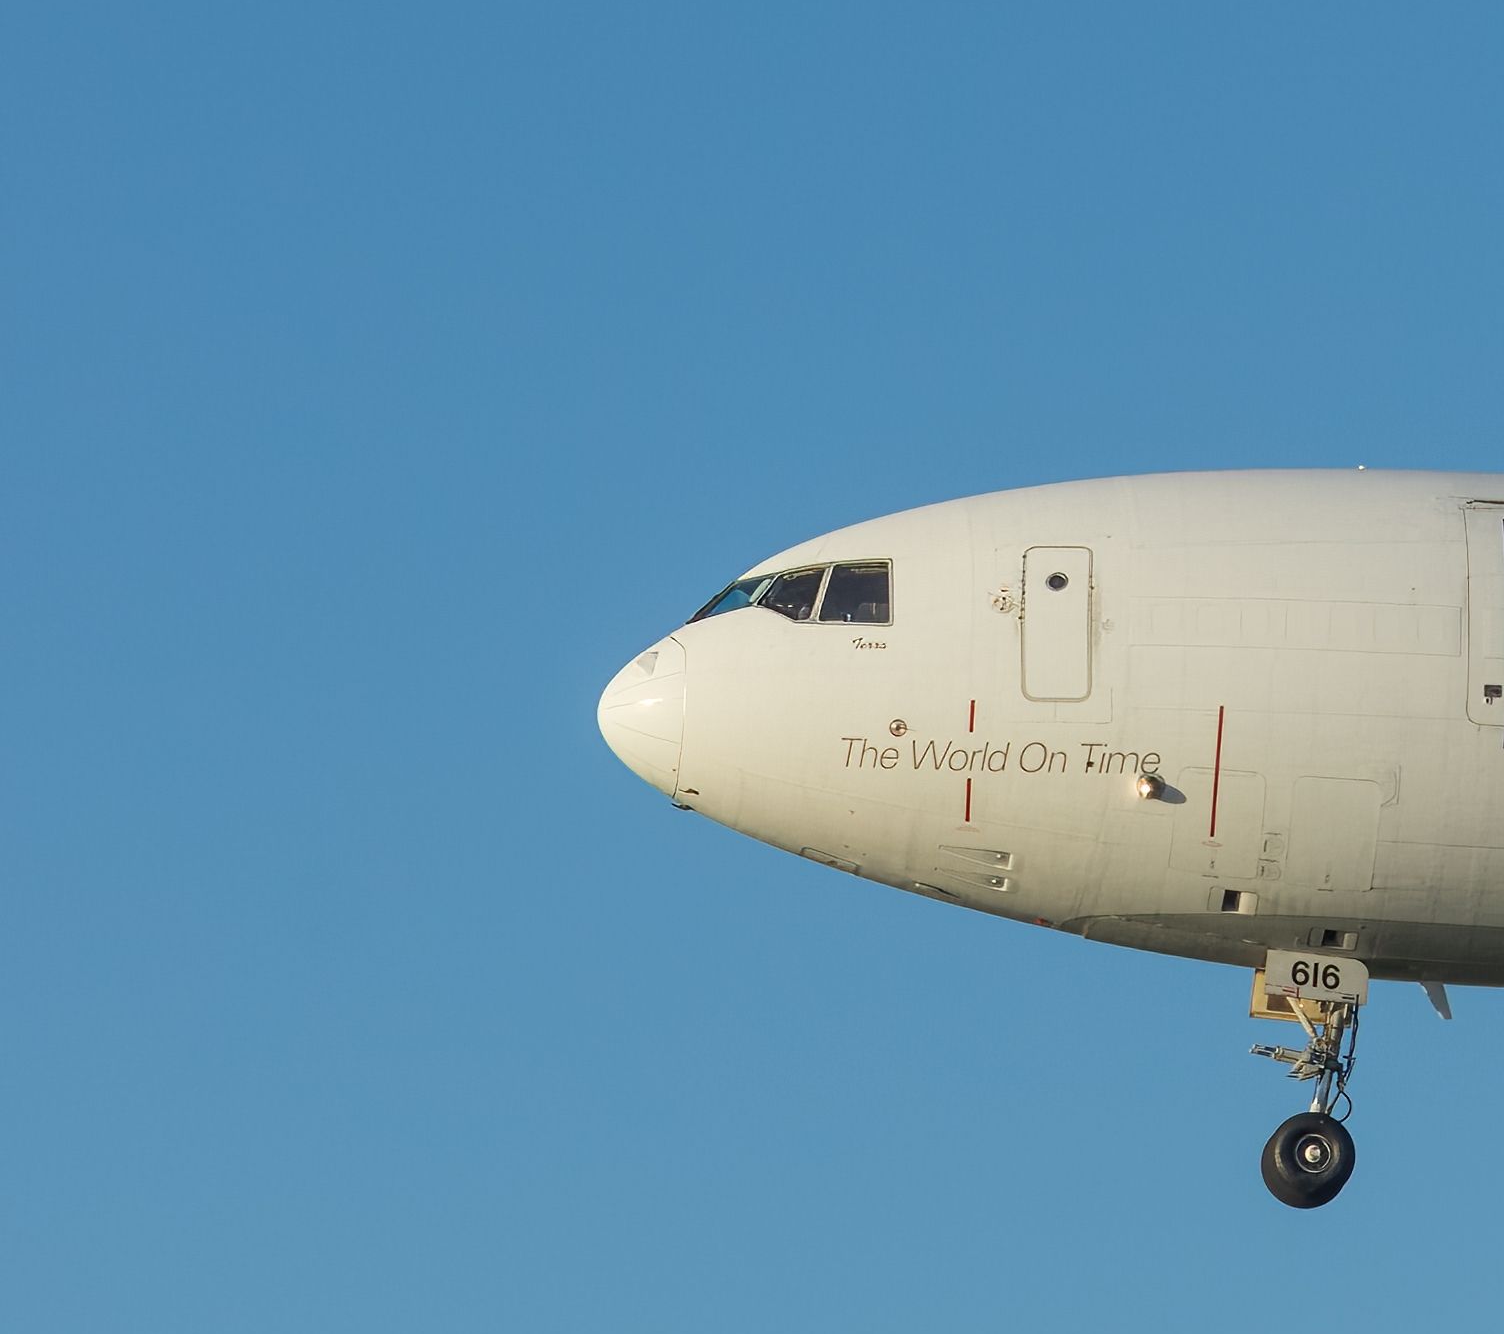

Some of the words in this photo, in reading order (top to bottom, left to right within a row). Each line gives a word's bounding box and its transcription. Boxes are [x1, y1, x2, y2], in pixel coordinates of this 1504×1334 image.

[841, 737, 899, 770] The
[912, 739, 1011, 772] World
[1019, 741, 1067, 774] On
[1081, 742, 1161, 774] Time
[1291, 960, 1340, 990] 616
